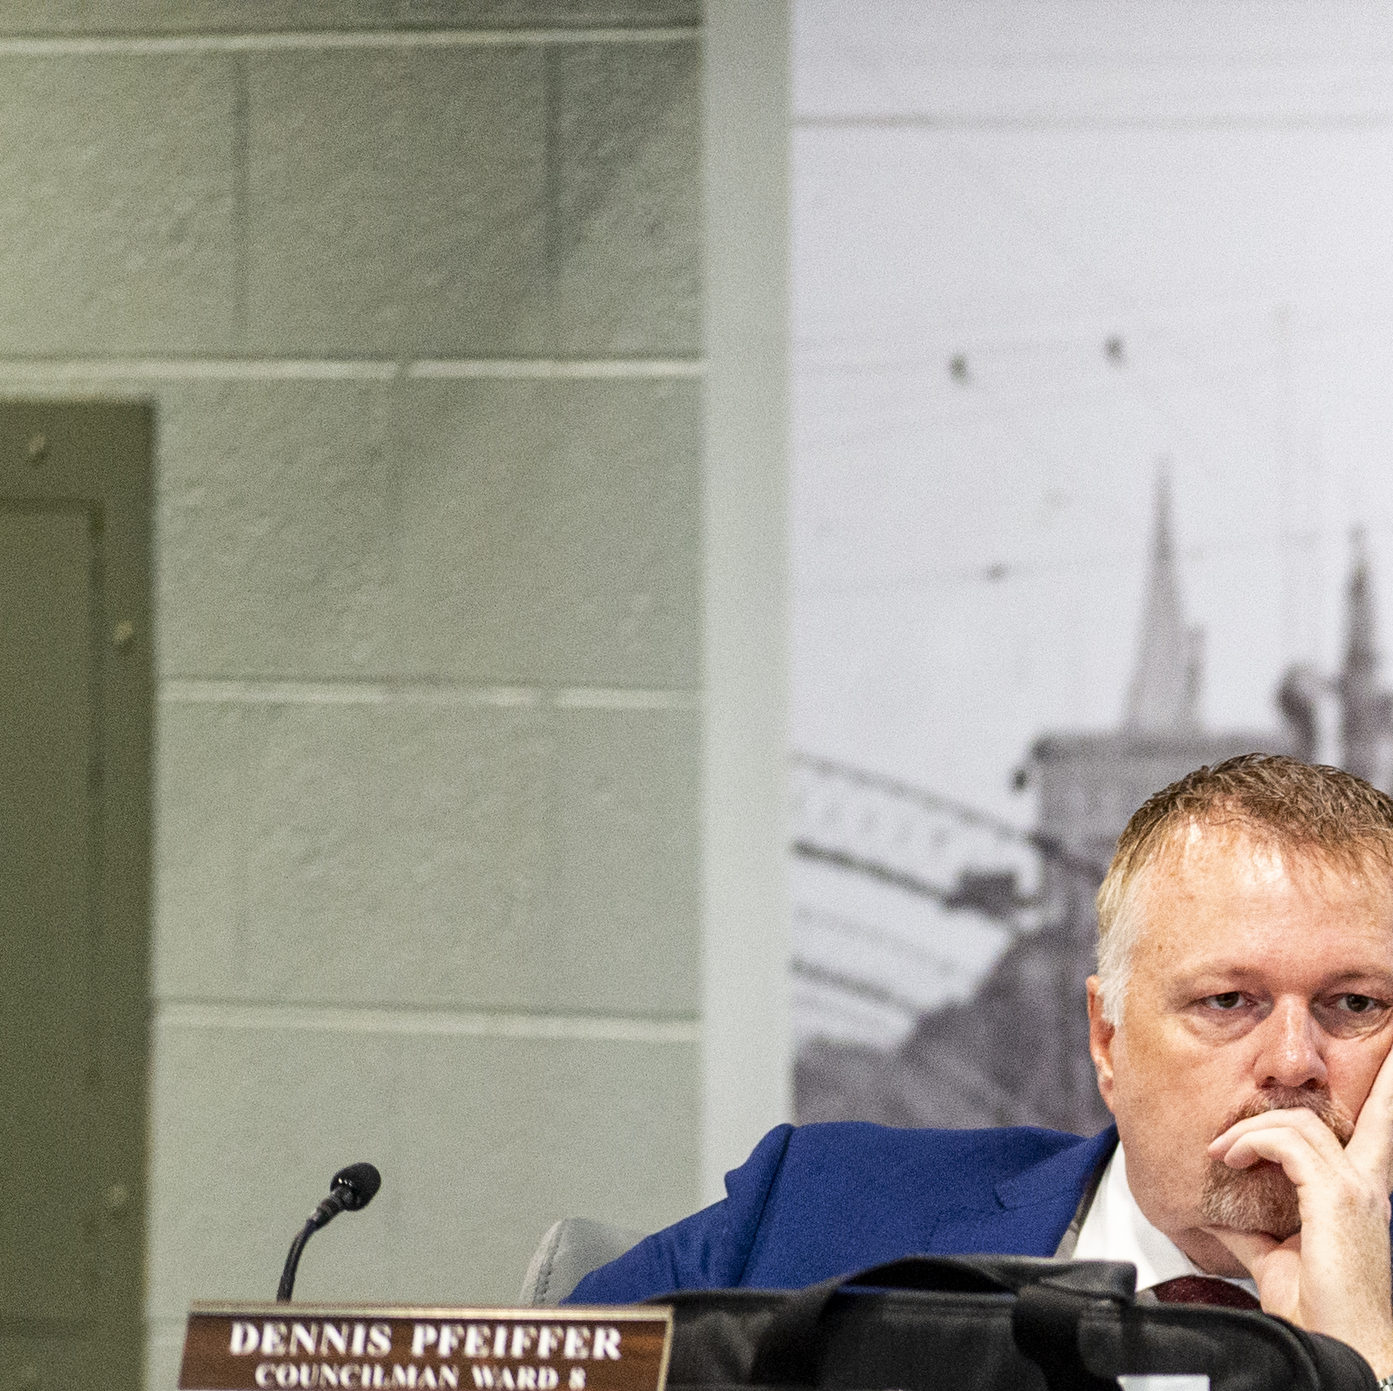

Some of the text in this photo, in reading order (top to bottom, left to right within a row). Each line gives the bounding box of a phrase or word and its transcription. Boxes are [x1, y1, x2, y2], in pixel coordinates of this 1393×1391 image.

[230, 1322, 622, 1360] DENNIS PFEIFFER
[255, 1363, 459, 1390] COUNCILMAN
[471, 1365, 560, 1391] WARD
